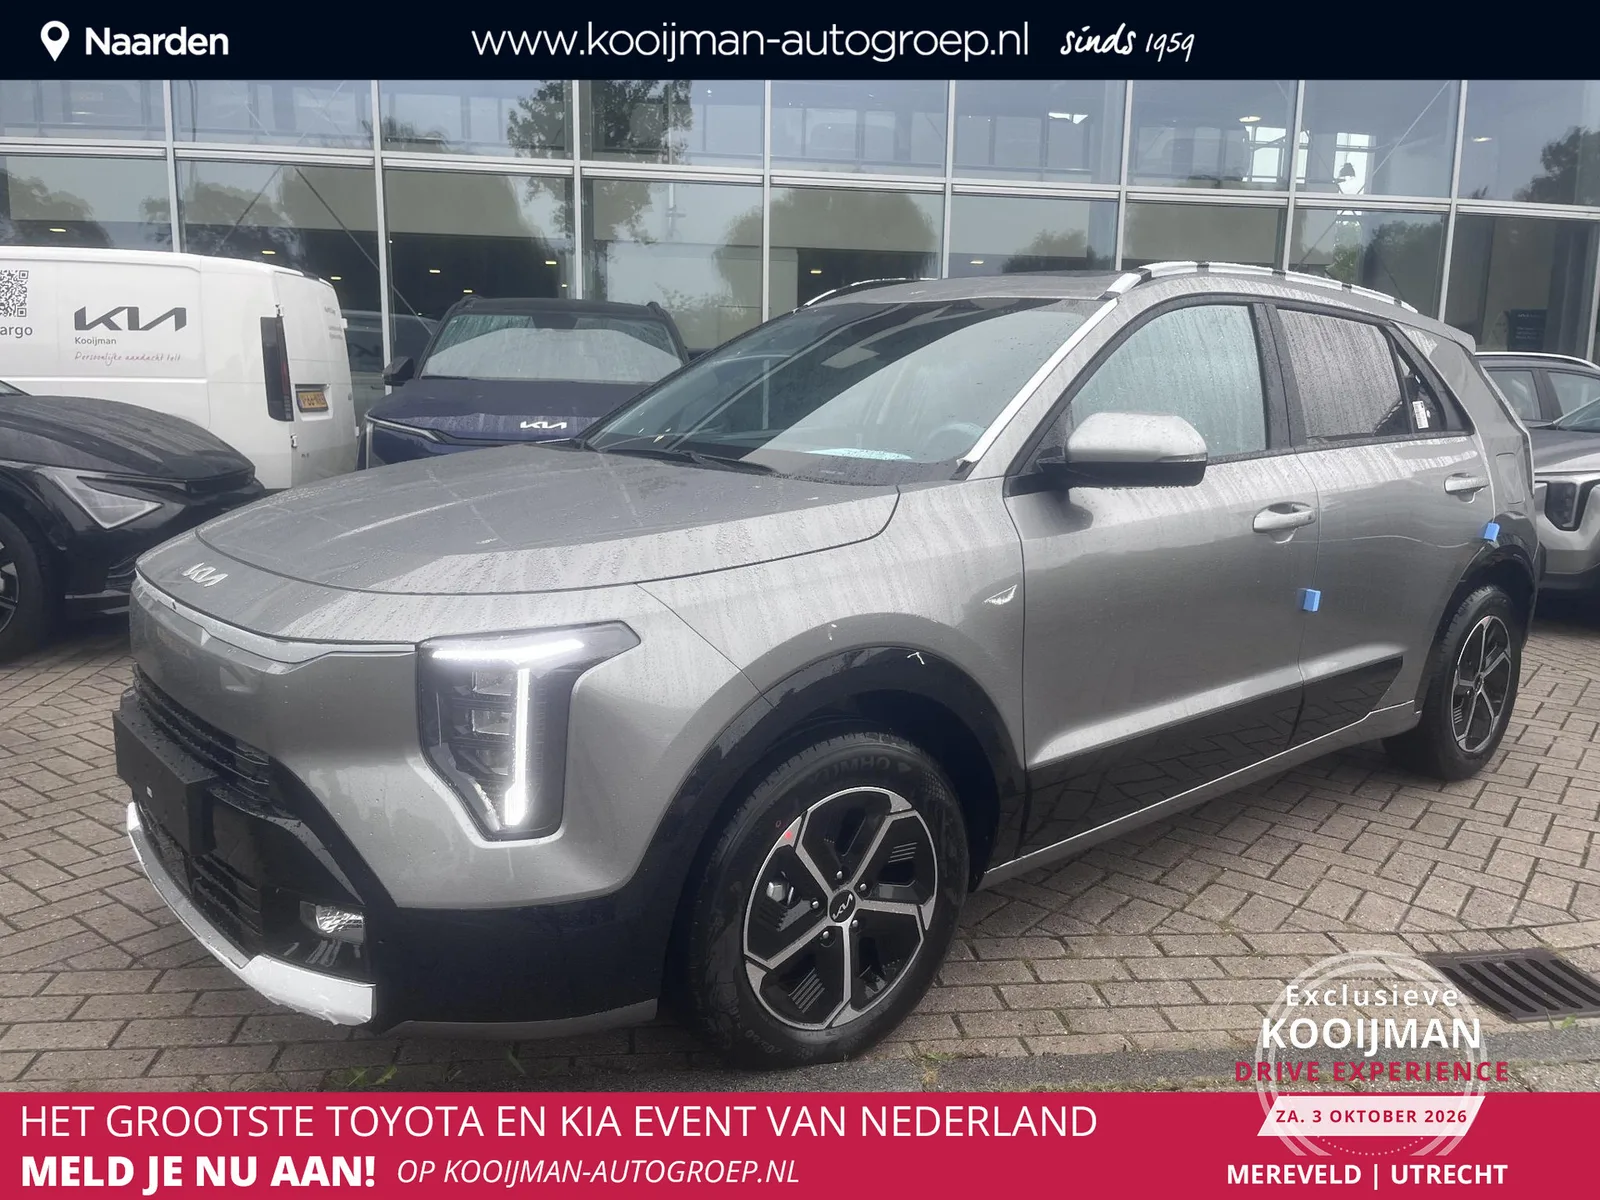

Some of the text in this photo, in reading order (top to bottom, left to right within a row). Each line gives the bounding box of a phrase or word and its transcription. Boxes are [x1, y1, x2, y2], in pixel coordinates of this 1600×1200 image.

[74, 306, 187, 331] KIA
[74, 336, 117, 346] Kooijman
[125, 353, 164, 361] aandacht
[520, 420, 568, 429] KIA
[181, 562, 229, 587] KIA
[808, 755, 891, 785] UMHO
